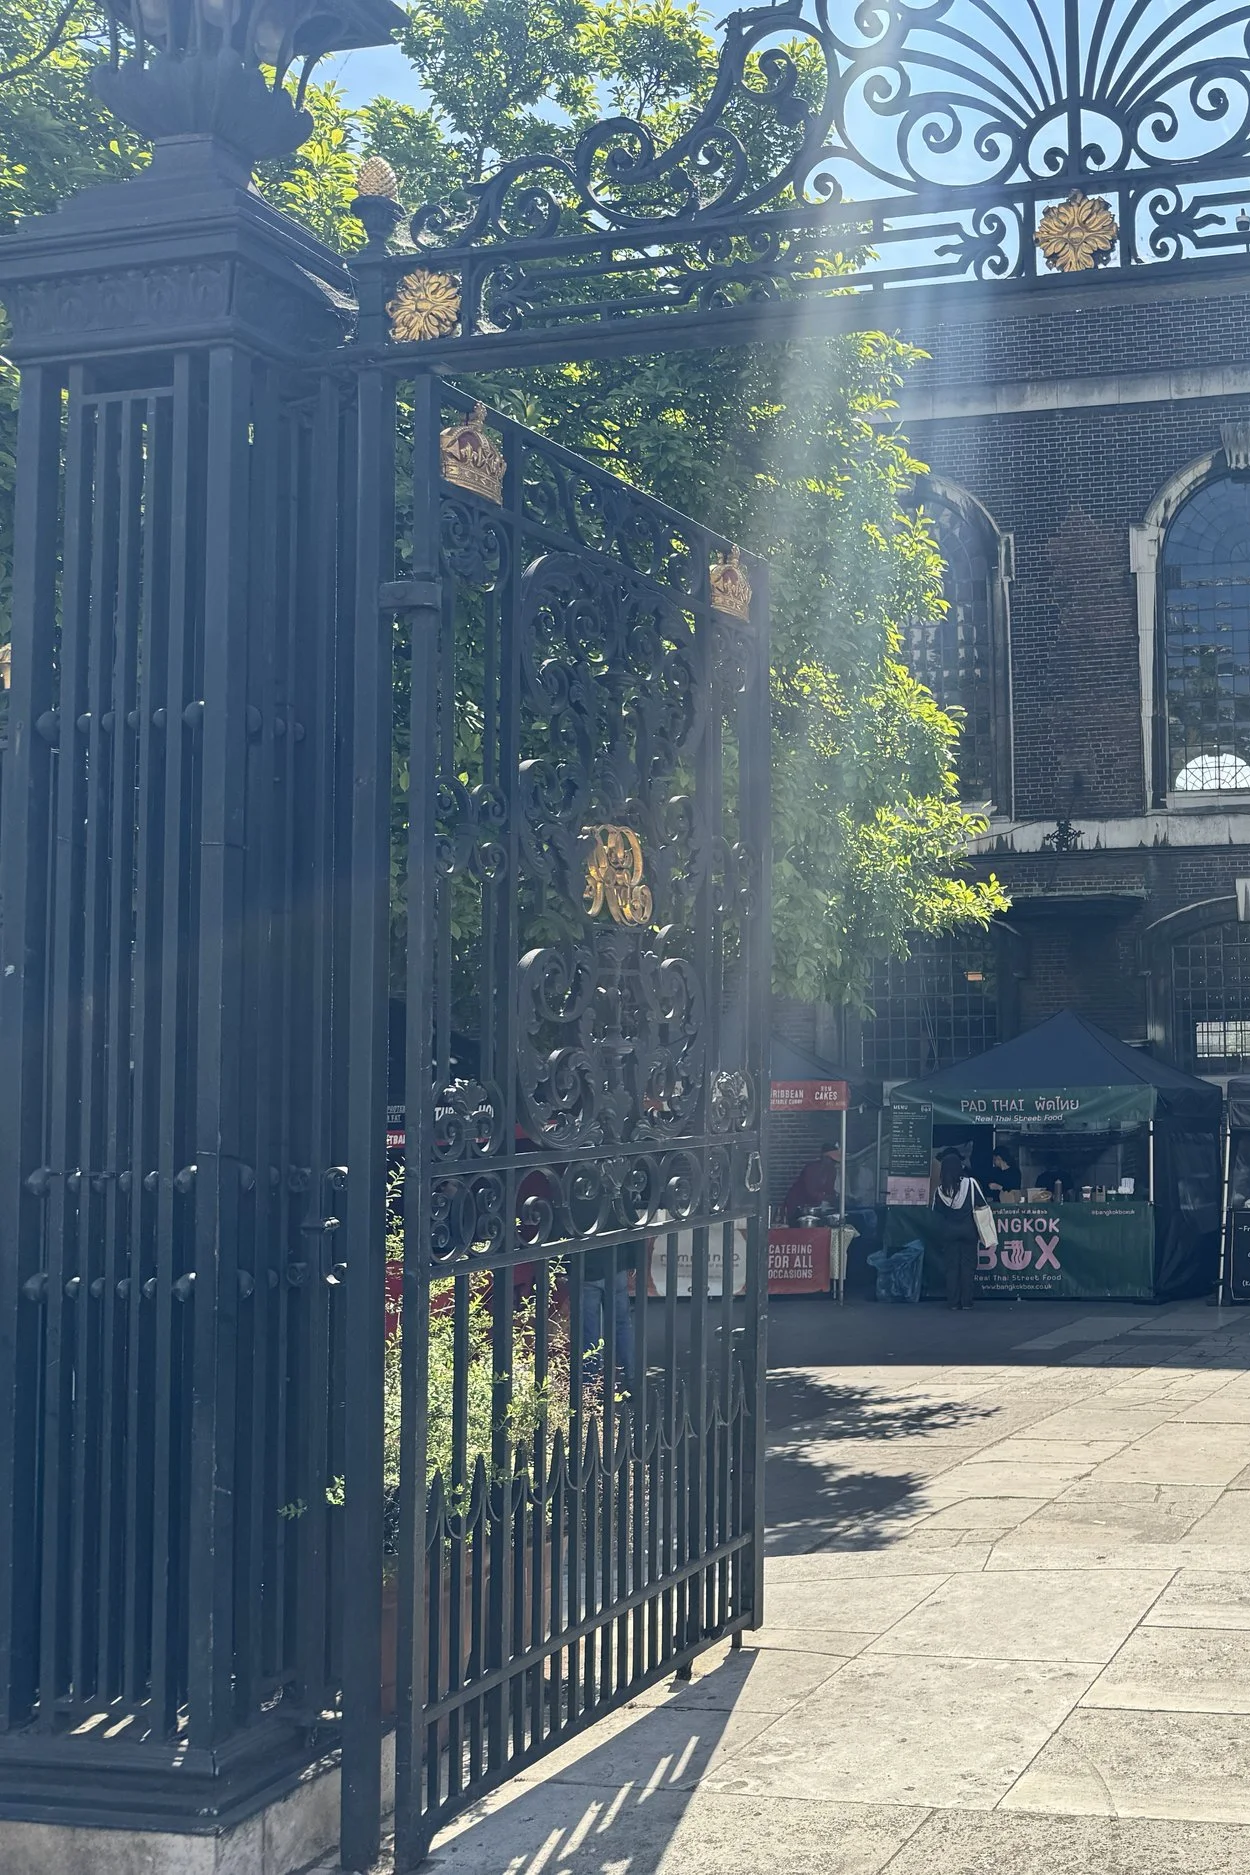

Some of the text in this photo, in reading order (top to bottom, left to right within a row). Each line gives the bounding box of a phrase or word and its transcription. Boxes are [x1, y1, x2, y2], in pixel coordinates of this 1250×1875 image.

[770, 1089, 804, 1098] RIBBEAN
[814, 1091, 838, 1101] CAKES
[961, 1099, 1025, 1112] PAD THAI
[1044, 1113, 1063, 1121] Food
[997, 1218, 1061, 1233] NGKOK
[769, 1244, 812, 1254] CATERING
[768, 1255, 814, 1269] FOR ALL
[768, 1269, 814, 1279] OCCASIONS
